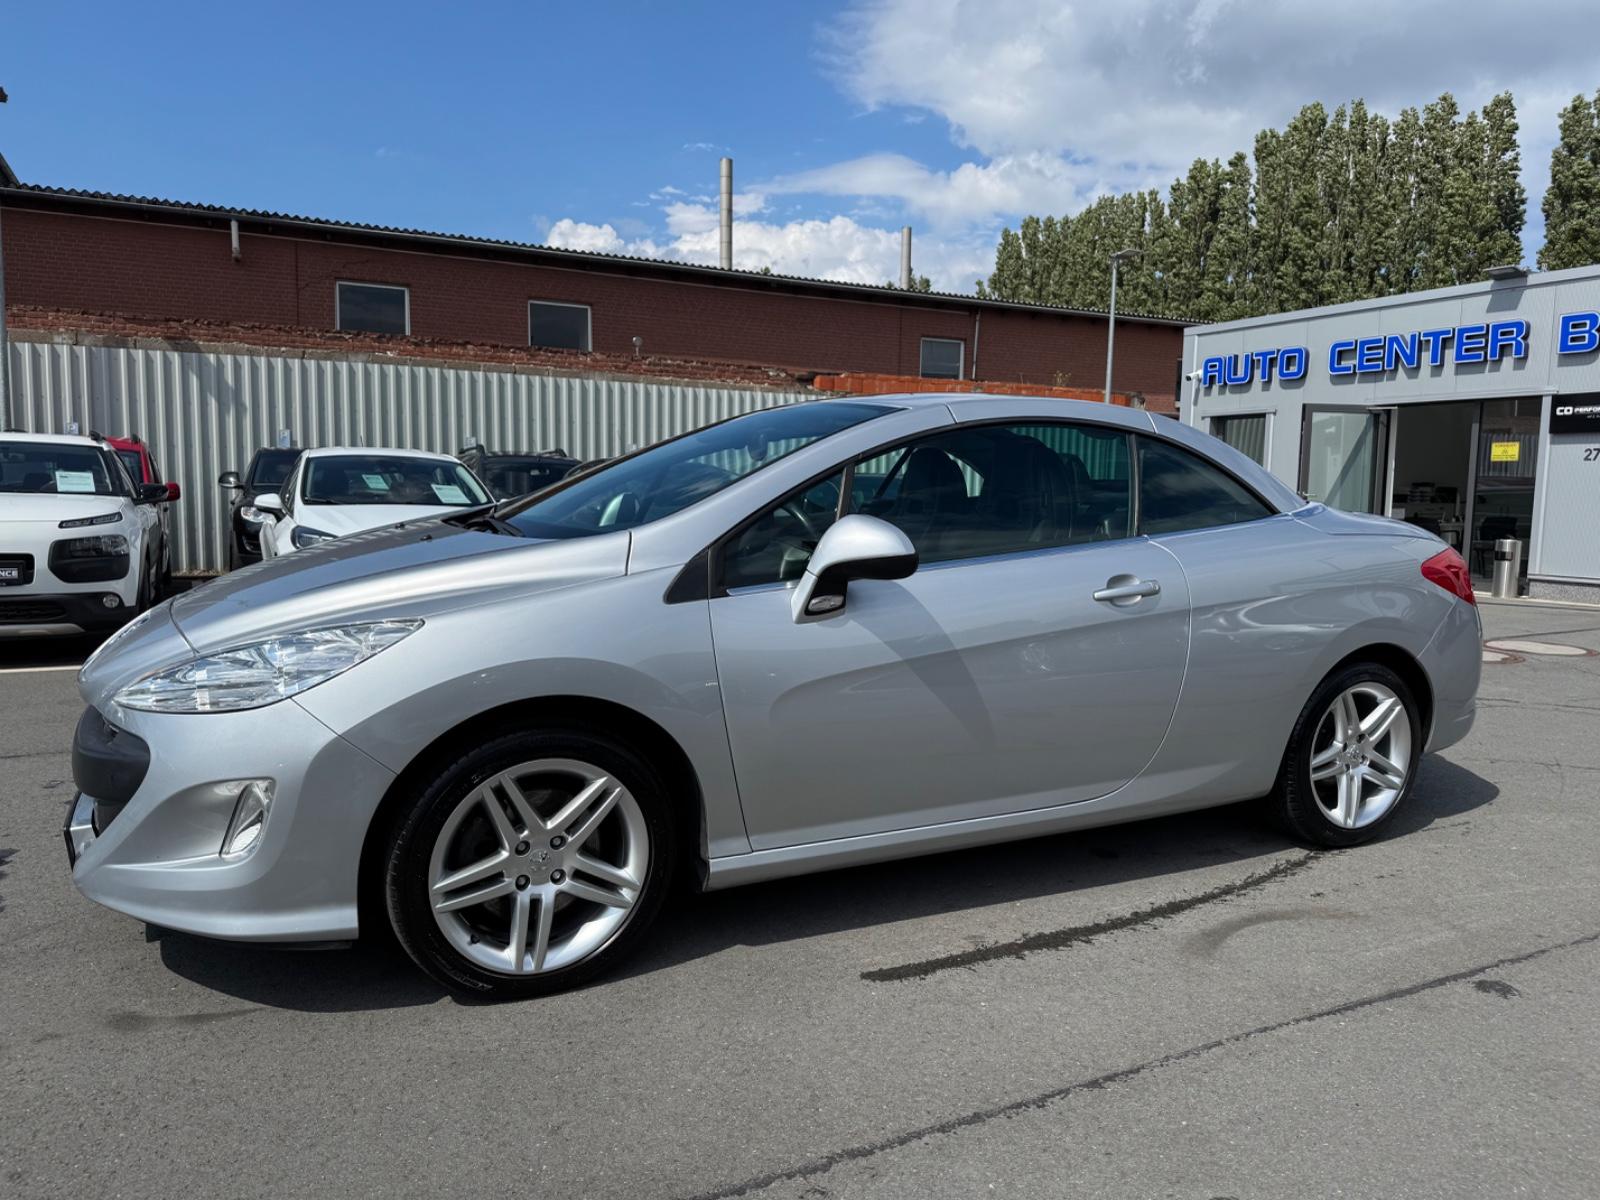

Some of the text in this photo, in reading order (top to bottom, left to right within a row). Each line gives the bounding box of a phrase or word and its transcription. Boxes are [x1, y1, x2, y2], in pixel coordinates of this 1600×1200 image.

[1202, 310, 1600, 388] AUTO CENTER B
[1583, 447, 1600, 462] 27
